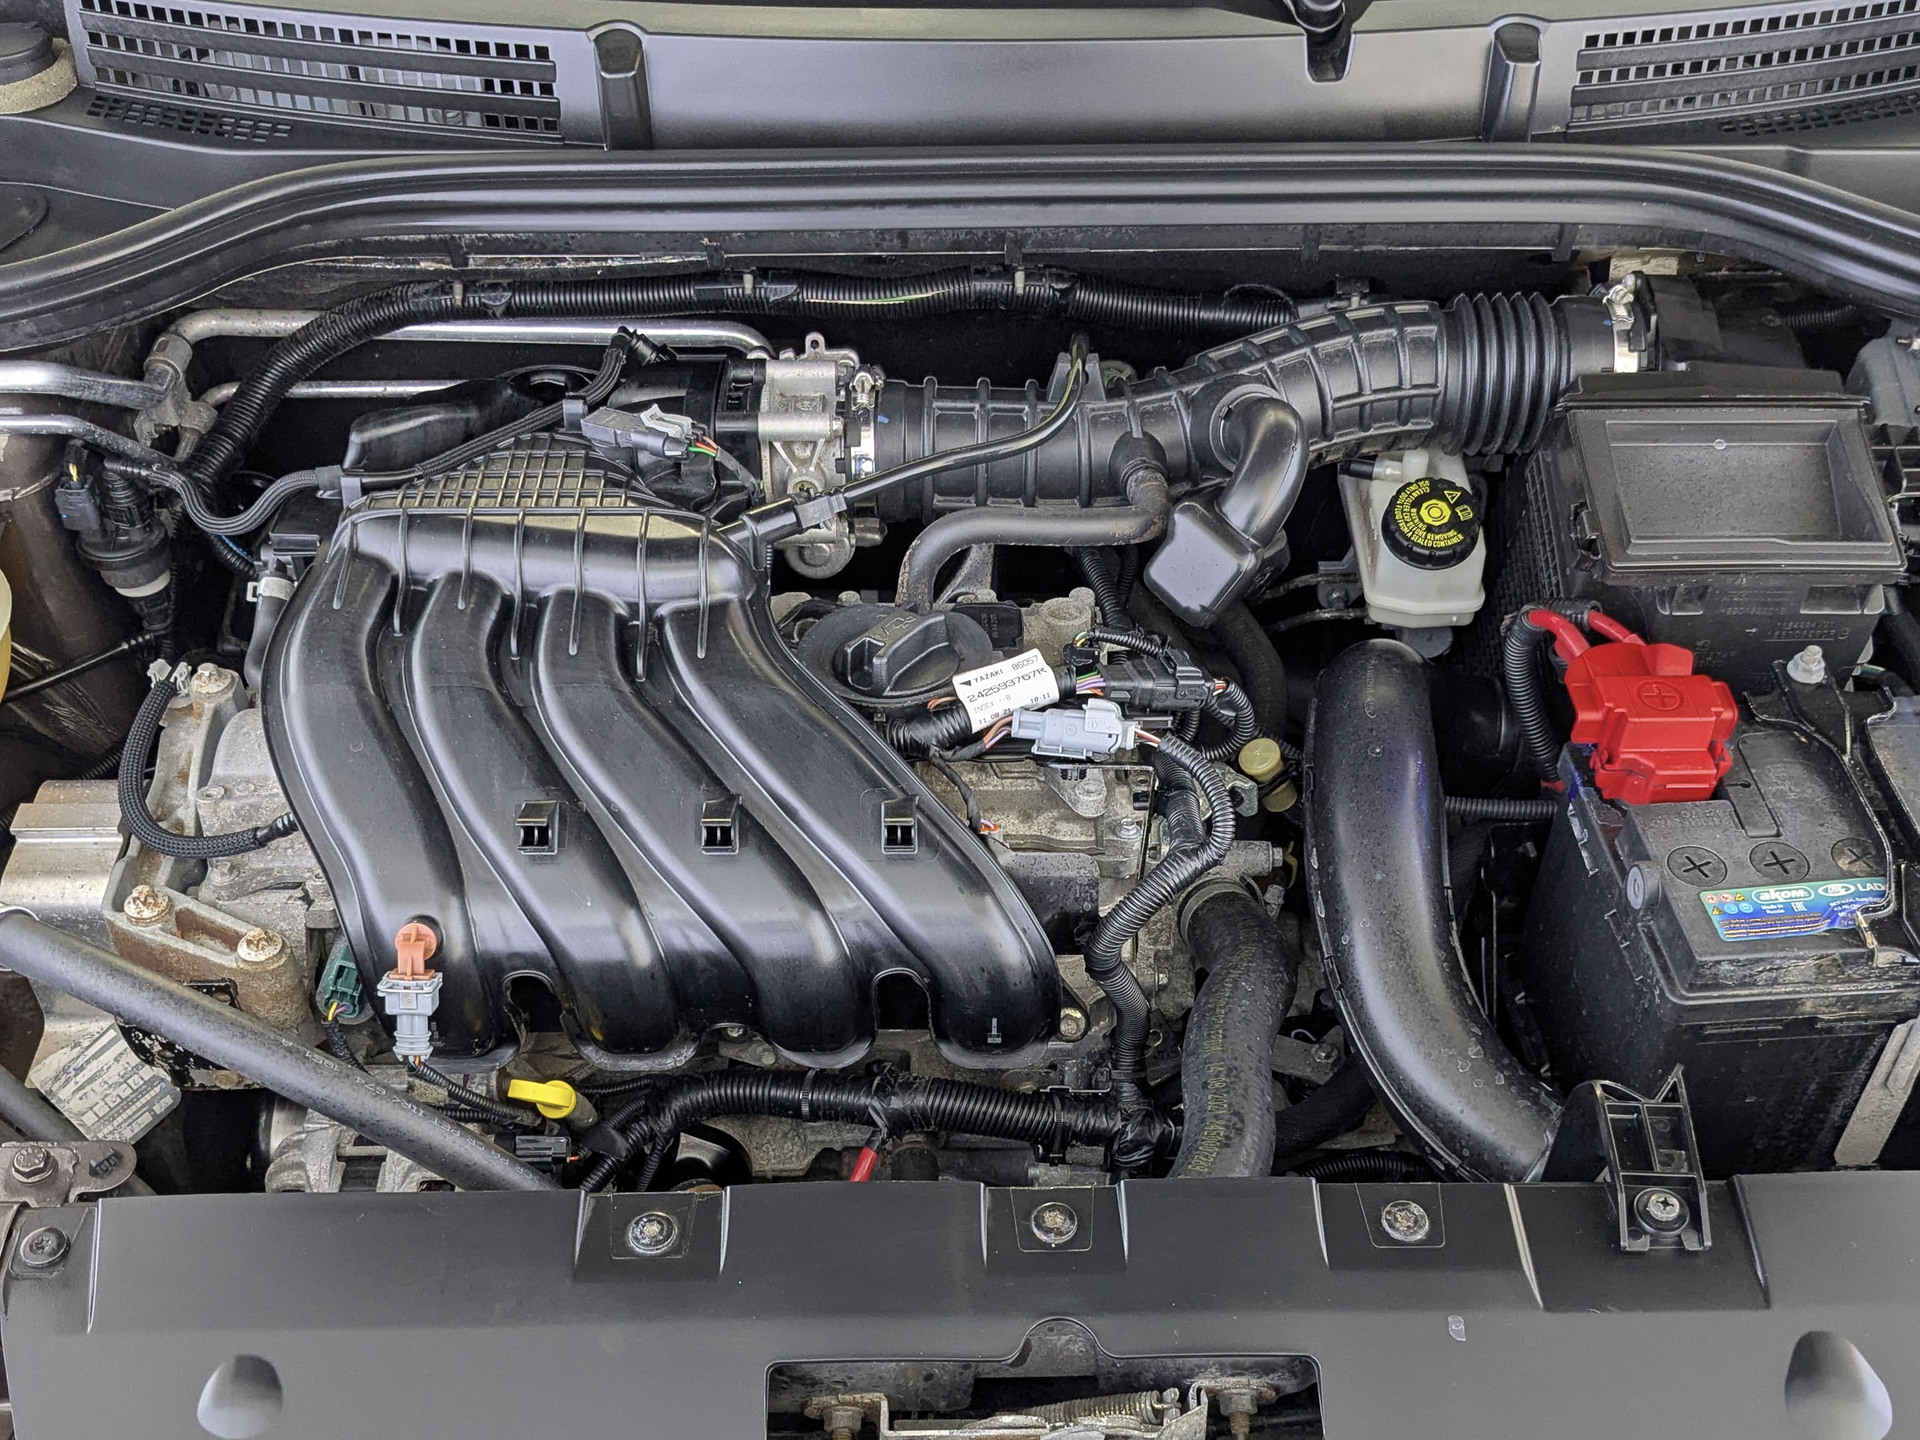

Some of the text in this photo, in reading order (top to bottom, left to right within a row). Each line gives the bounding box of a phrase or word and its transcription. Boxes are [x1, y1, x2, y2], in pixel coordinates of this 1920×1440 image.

[1412, 487, 1430, 497] CLEAN
[1407, 522, 1427, 538] BEFORE
[1427, 530, 1457, 540] REMOVING
[1411, 535, 1432, 547] SEALED
[1433, 534, 1464, 547] CONTAINER
[972, 655, 1039, 684] YAZAKI 86057
[1857, 882, 1887, 892] LAD
[282, 1039, 293, 1048] A
[356, 1076, 387, 1096] 674
[1207, 1093, 1227, 1114] 2021
[430, 1117, 462, 1137] PET
[465, 1136, 486, 1152] CR
[491, 1150, 509, 1166] PA
